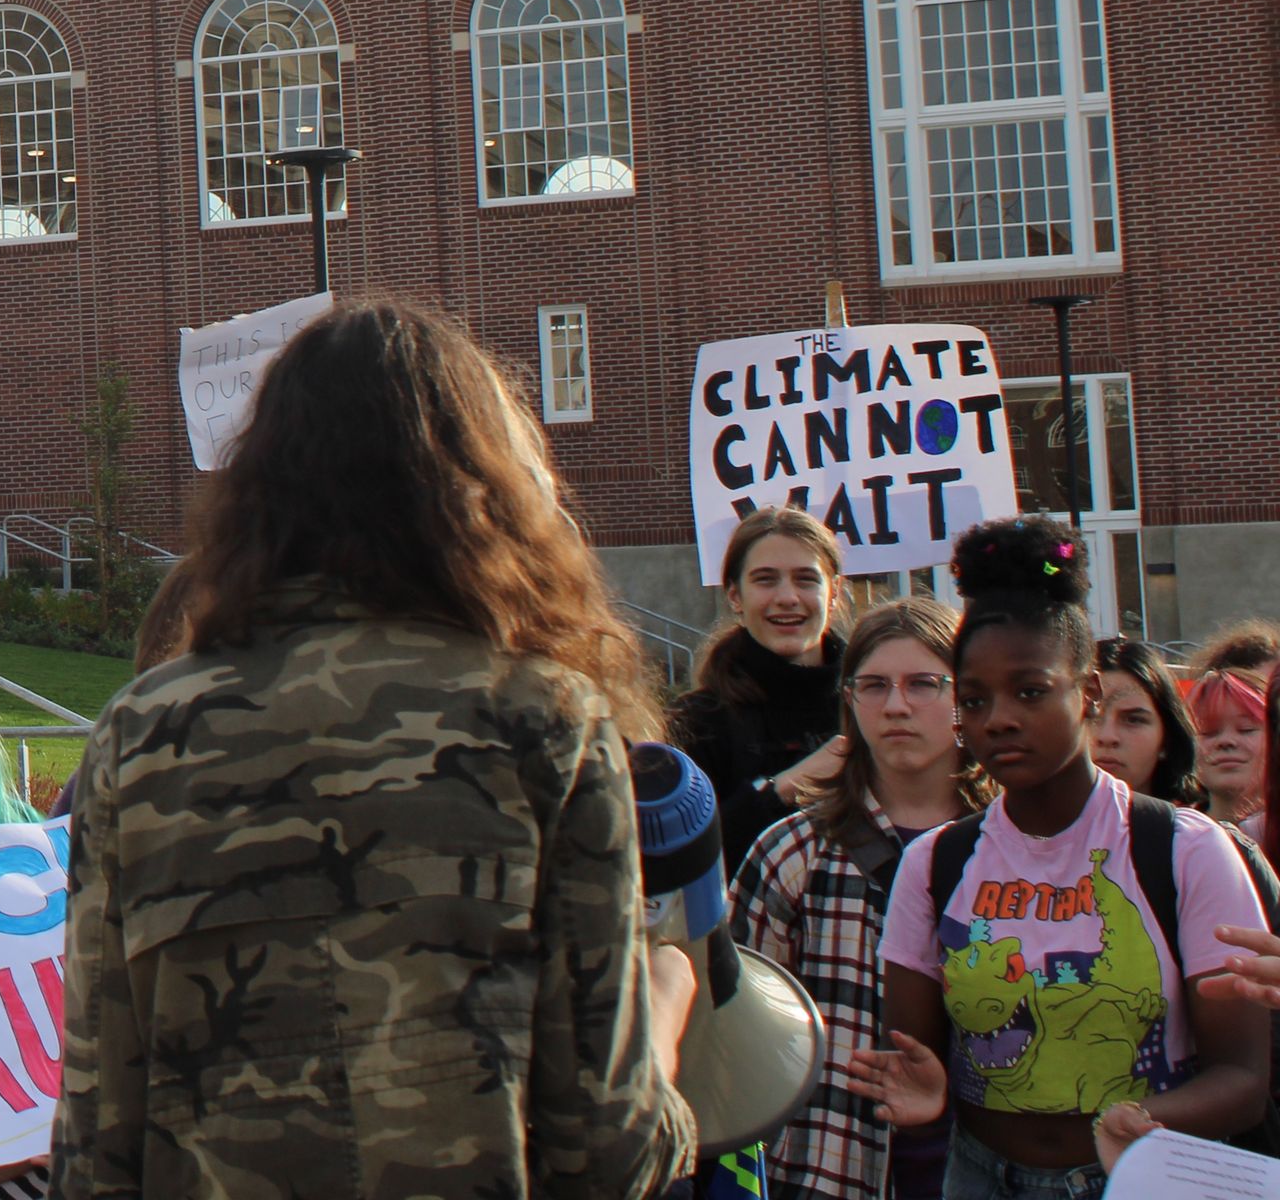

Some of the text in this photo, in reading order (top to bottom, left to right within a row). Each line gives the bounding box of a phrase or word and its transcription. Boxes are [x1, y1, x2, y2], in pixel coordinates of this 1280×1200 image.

[191, 328, 263, 375] THIS
[794, 332, 841, 356] THE
[194, 370, 255, 412] OUR
[702, 339, 989, 417] CLIMATE
[972, 875, 1094, 922] REPTAR
